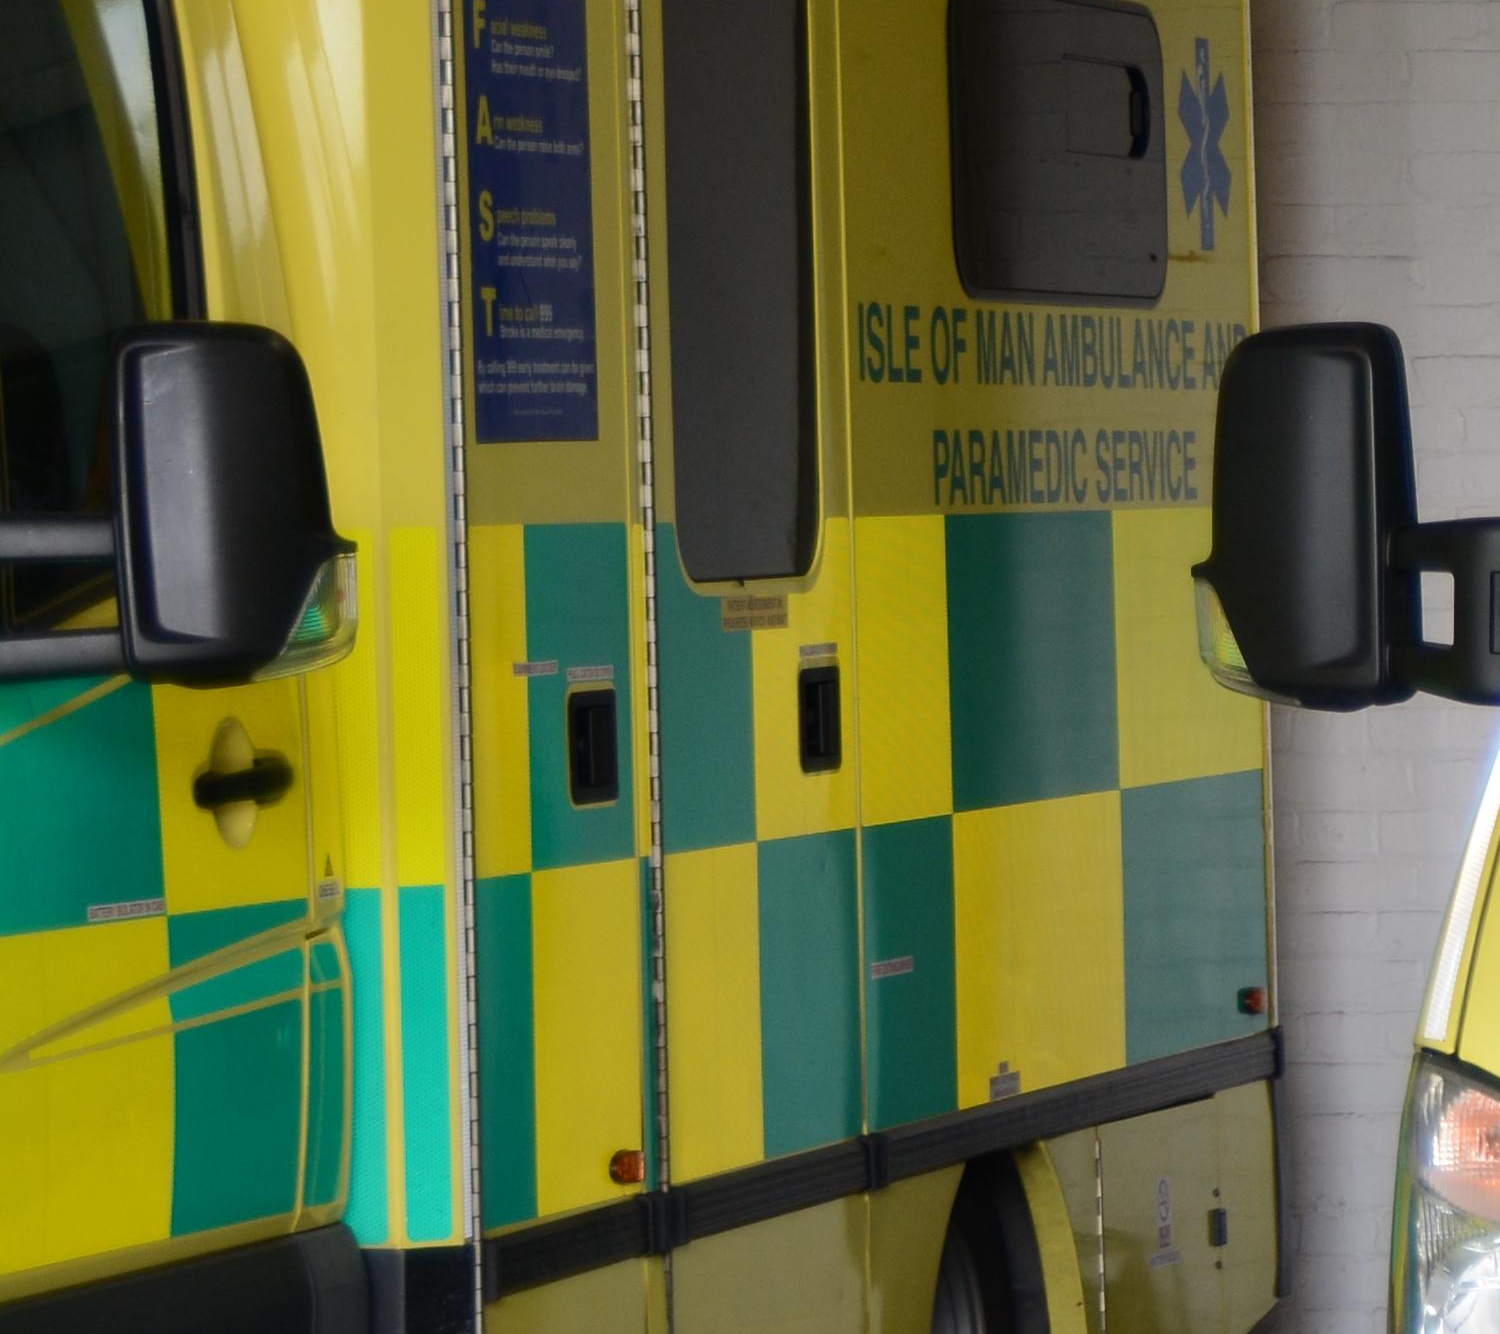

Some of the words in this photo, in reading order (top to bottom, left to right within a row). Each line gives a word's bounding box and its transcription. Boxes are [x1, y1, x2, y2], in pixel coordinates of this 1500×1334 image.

[476, 94, 494, 146] A
[479, 189, 495, 243] S
[480, 286, 497, 337] T
[857, 301, 923, 384] ISLE
[931, 305, 967, 386] OF
[976, 309, 1034, 386] MAN
[1043, 313, 1197, 391] AMBULANCE
[932, 427, 1088, 506] PARAMEDIC
[1095, 427, 1198, 505] SERVICE
